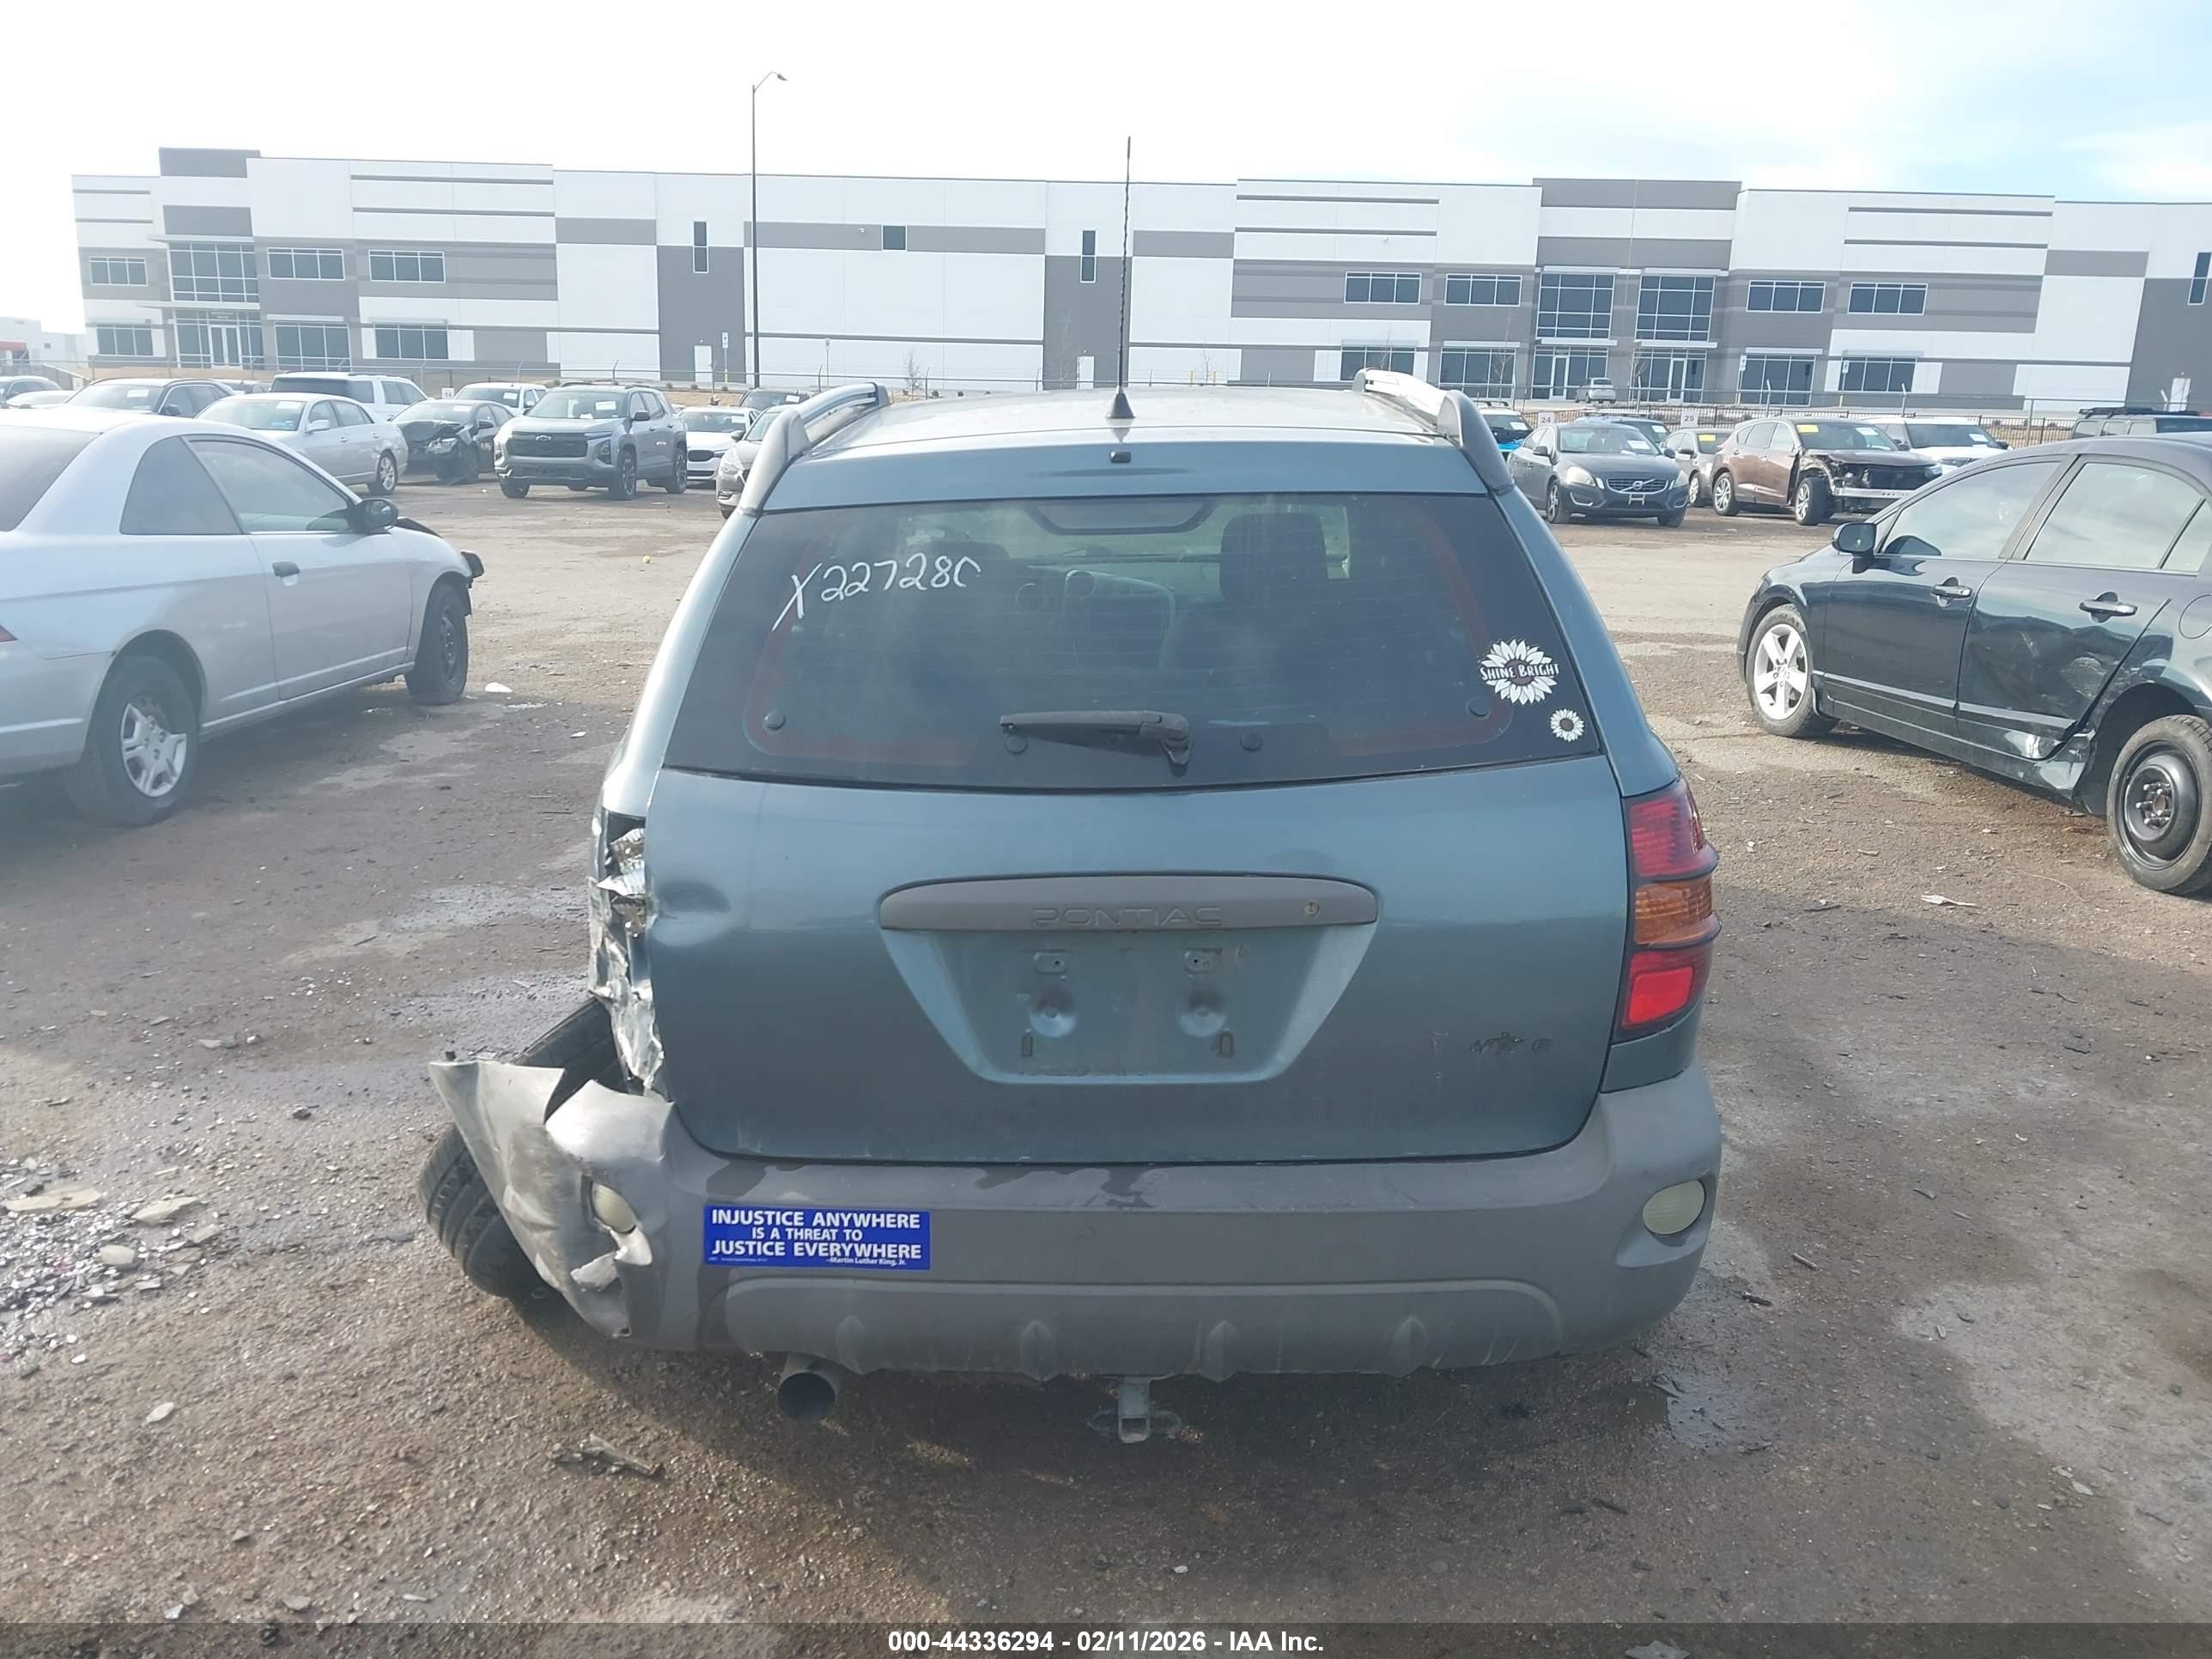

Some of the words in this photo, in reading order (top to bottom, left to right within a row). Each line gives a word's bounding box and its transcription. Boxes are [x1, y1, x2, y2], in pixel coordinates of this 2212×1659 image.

[1480, 665, 1516, 681] SHINE
[1517, 663, 1559, 678] BRIGHT
[1031, 907, 1223, 927] PONTIAC
[711, 1209, 805, 1226] INJUSTICE
[811, 1212, 921, 1229] ANYWHERE
[751, 1226, 765, 1239] IS
[769, 1227, 781, 1240] A
[785, 1228, 838, 1241] THREAT
[842, 1229, 864, 1242] TO
[711, 1240, 786, 1256] JUSTICE
[793, 1242, 922, 1259] EVERYWHERE
